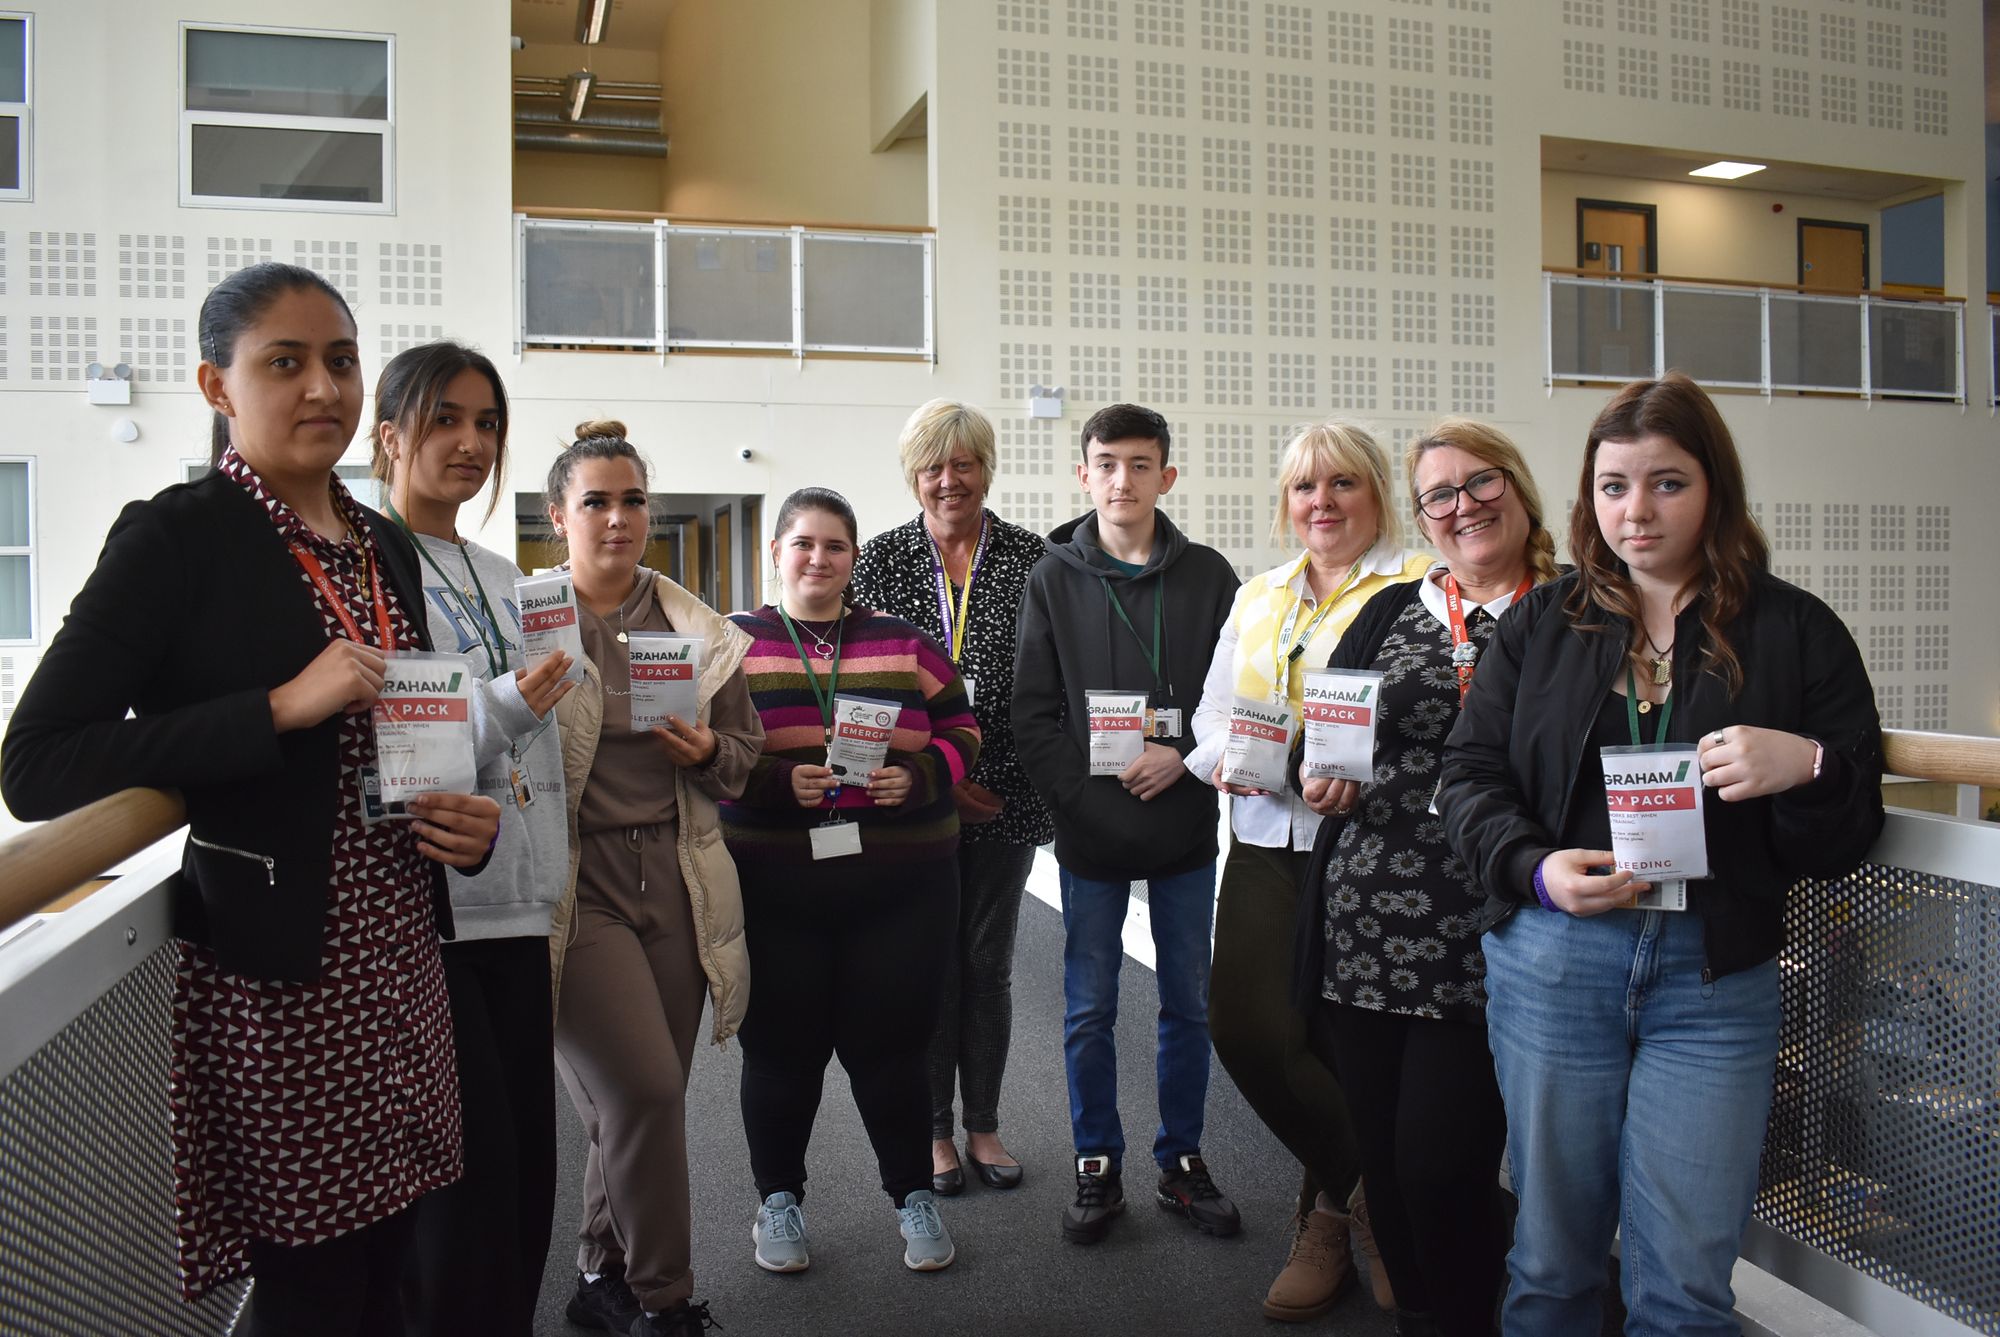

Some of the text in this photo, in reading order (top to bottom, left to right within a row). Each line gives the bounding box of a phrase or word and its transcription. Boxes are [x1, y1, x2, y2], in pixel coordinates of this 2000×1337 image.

[1449, 594, 1458, 612] STAFF
[540, 612, 566, 625] PACK
[647, 668, 679, 676] PACK
[384, 680, 446, 692] RAHAM
[402, 704, 449, 715] PACK
[1089, 706, 1131, 714] GRAHAM
[1320, 708, 1356, 720] PACK
[1245, 724, 1275, 737] PACK
[1603, 771, 1673, 786] GRAHAM
[1630, 794, 1676, 806] PACK
[1615, 860, 1672, 869] LEEDING
